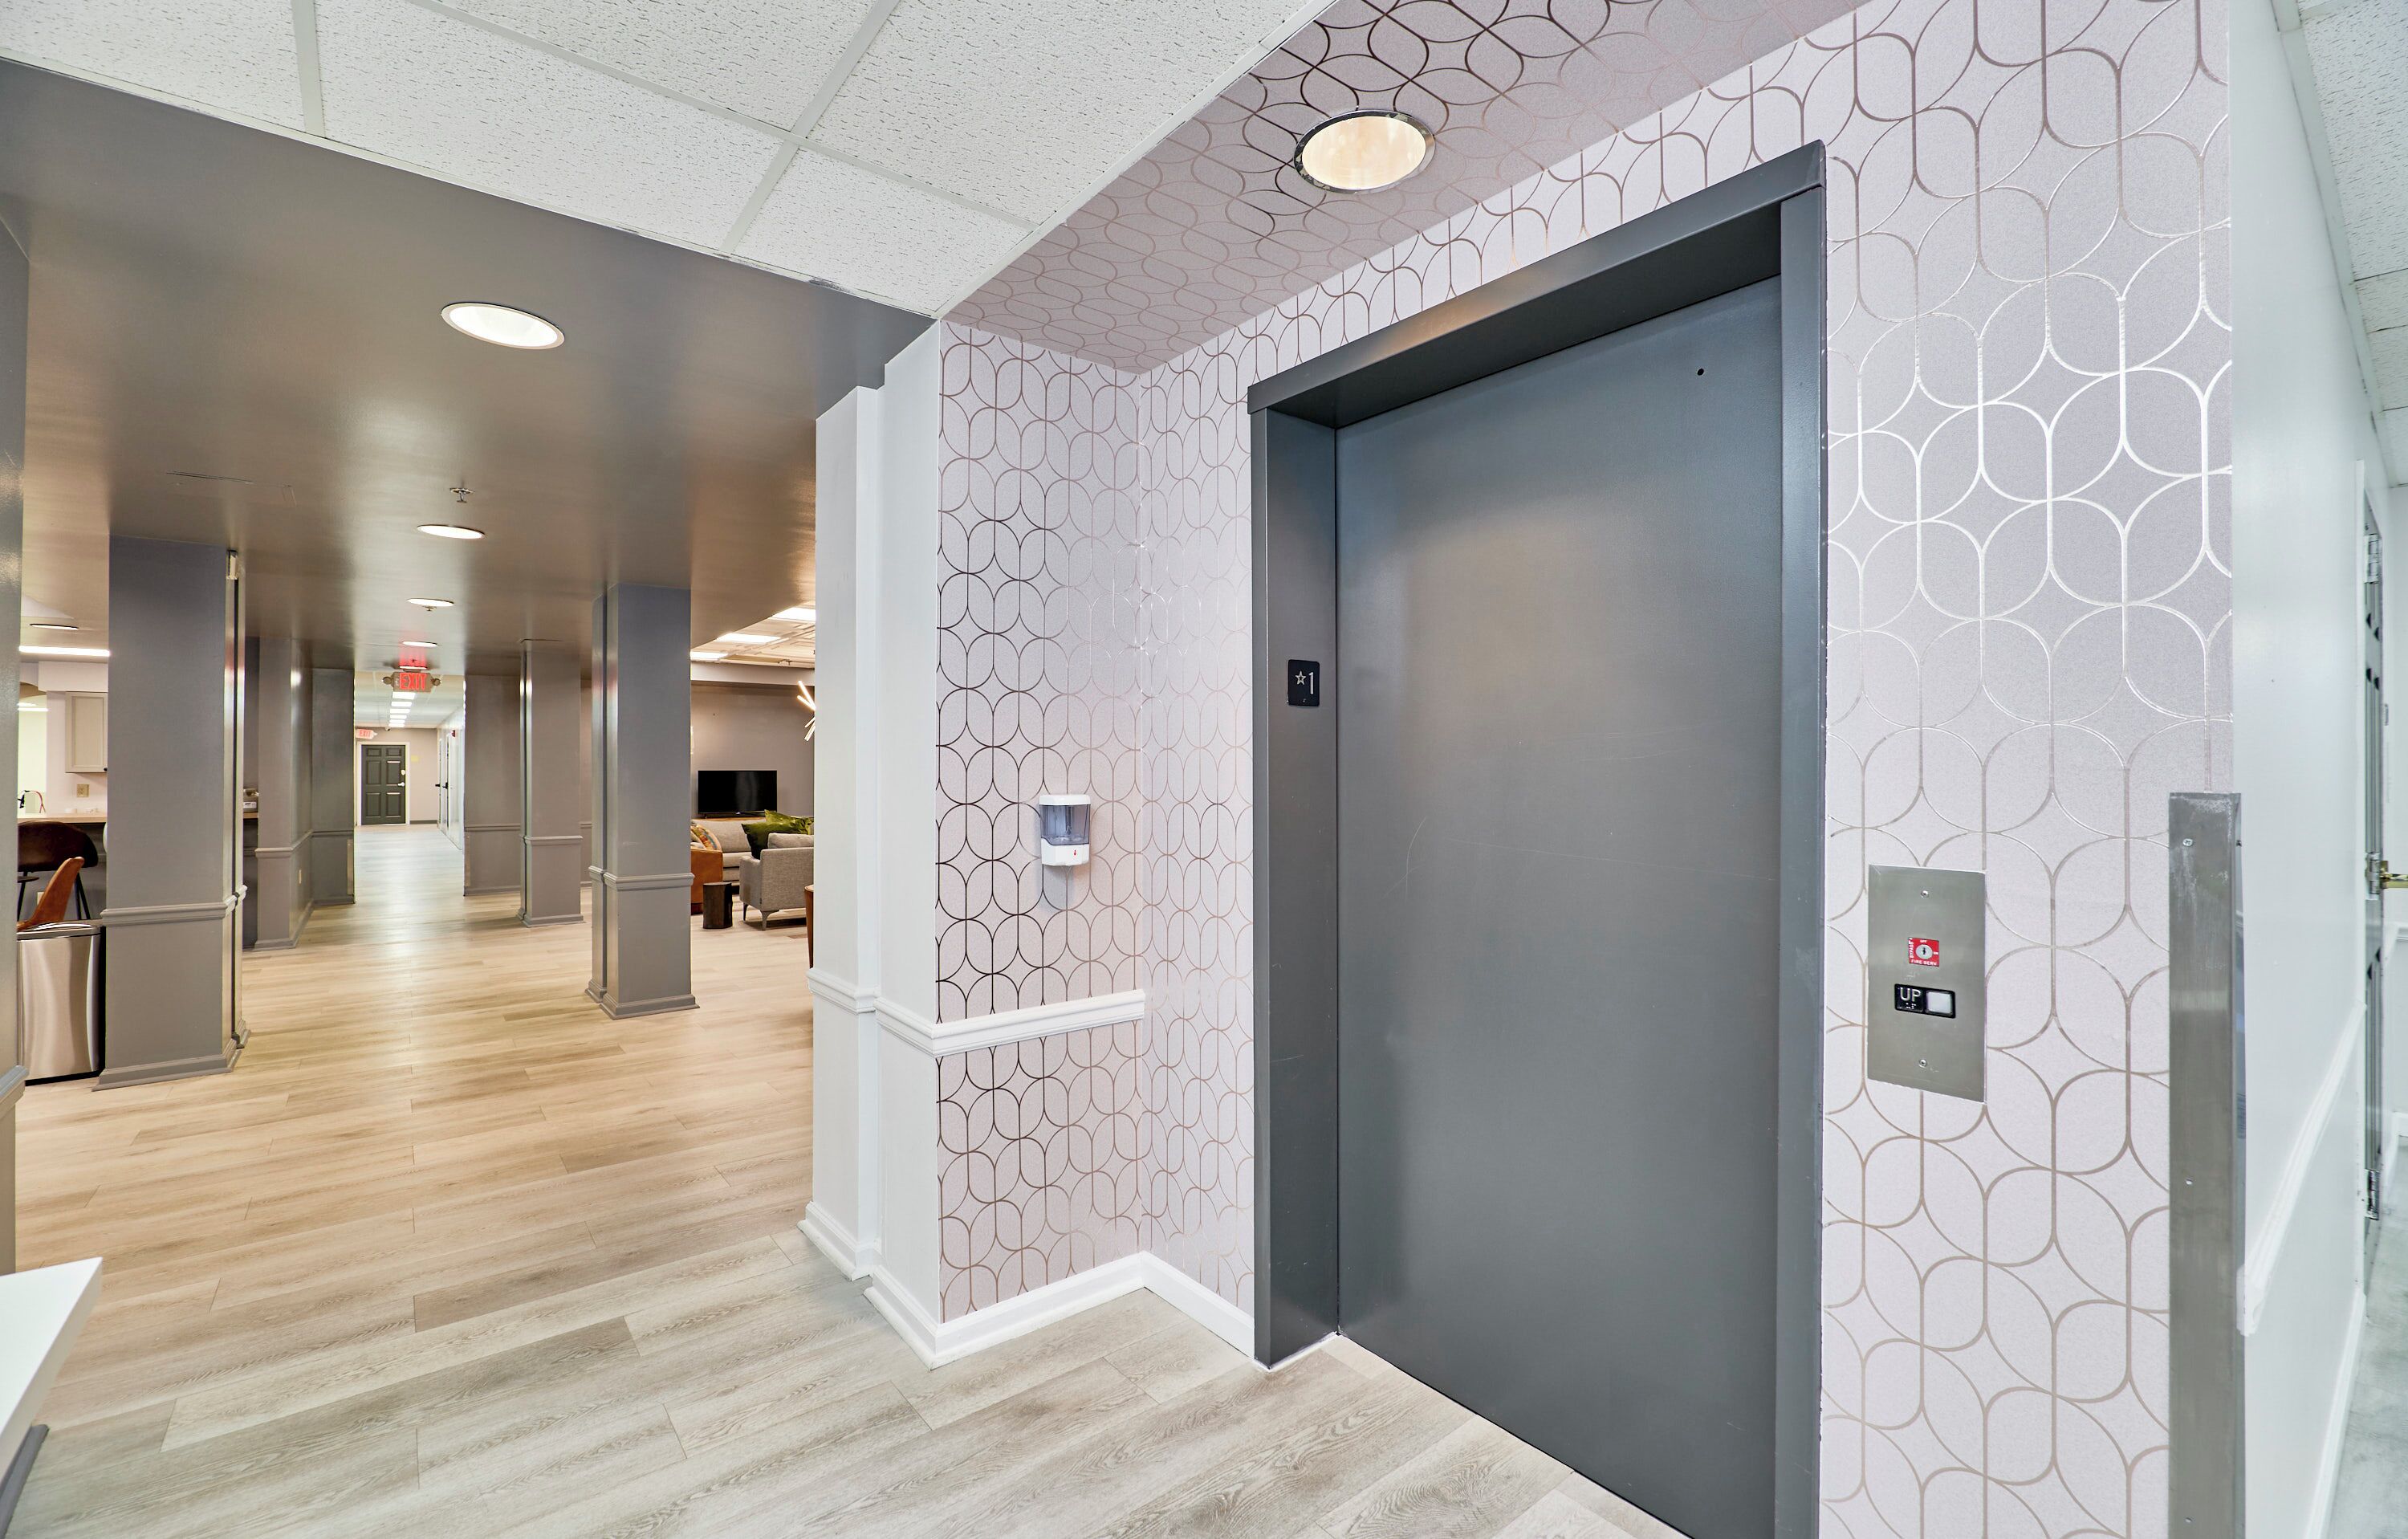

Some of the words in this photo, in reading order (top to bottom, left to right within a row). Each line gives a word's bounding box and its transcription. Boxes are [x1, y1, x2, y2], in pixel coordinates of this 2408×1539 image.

[399, 673, 427, 690] EXIT
[1308, 672, 1314, 694] 1
[359, 729, 371, 739] EXIT
[1900, 987, 1921, 1002] UP
